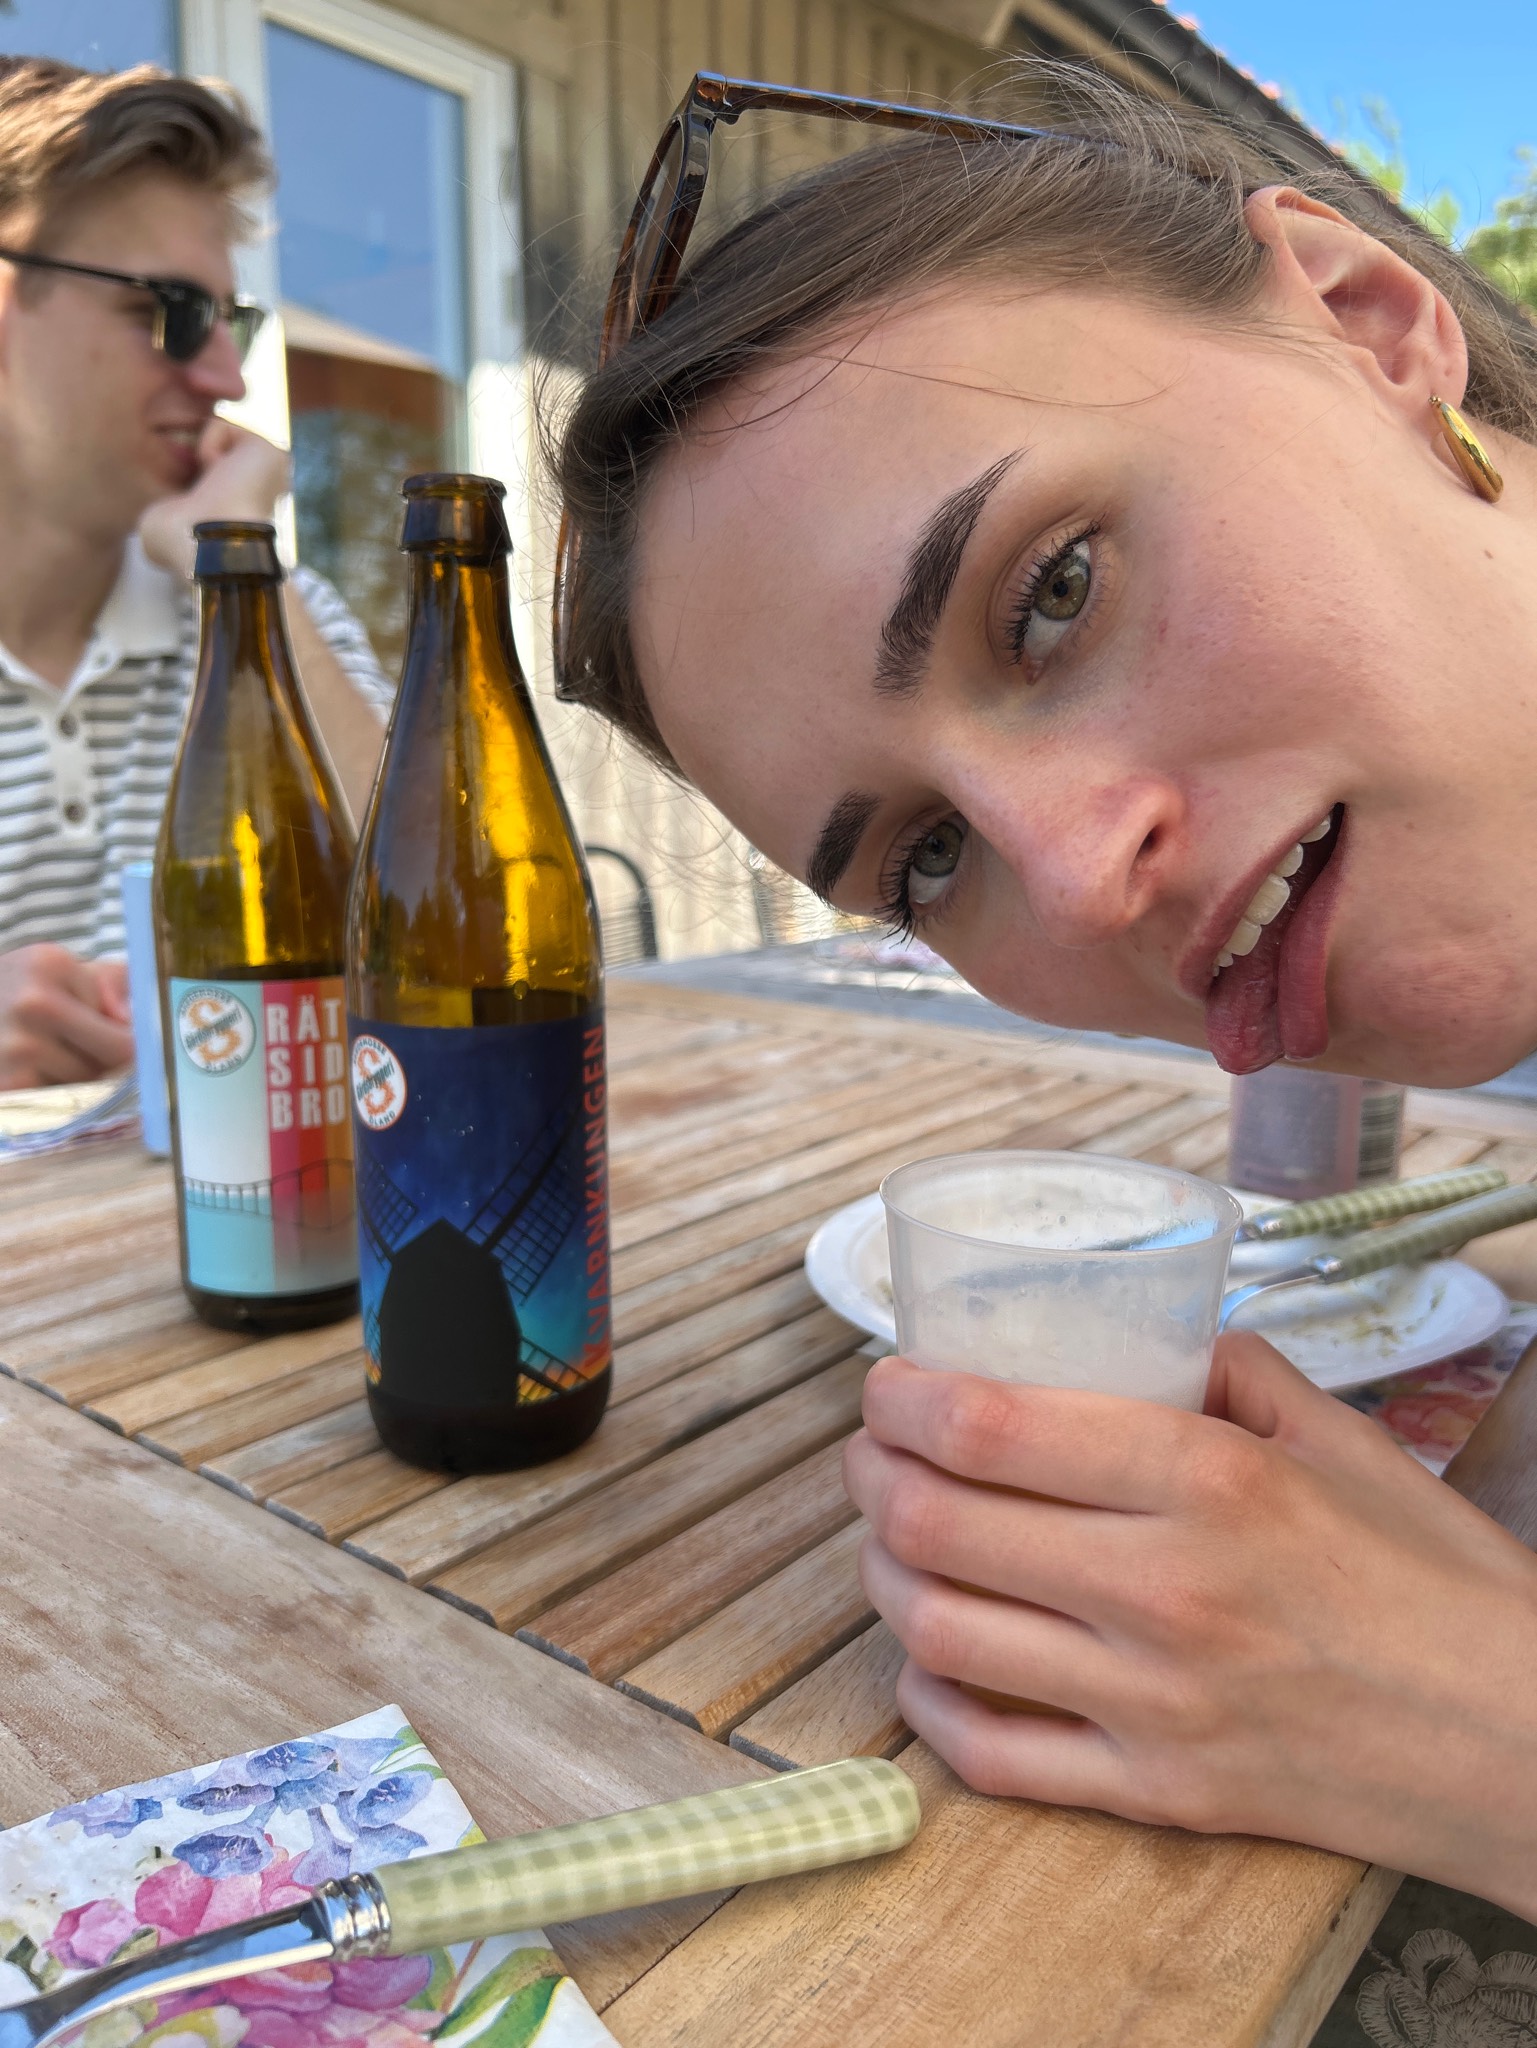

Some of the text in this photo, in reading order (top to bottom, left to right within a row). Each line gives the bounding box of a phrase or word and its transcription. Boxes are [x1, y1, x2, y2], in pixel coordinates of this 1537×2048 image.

[267, 994, 341, 1045] RÄT
[268, 1041, 345, 1088] SID
[271, 1084, 346, 1131] BRO
[583, 1024, 611, 1368] KVARNKUNGEN
